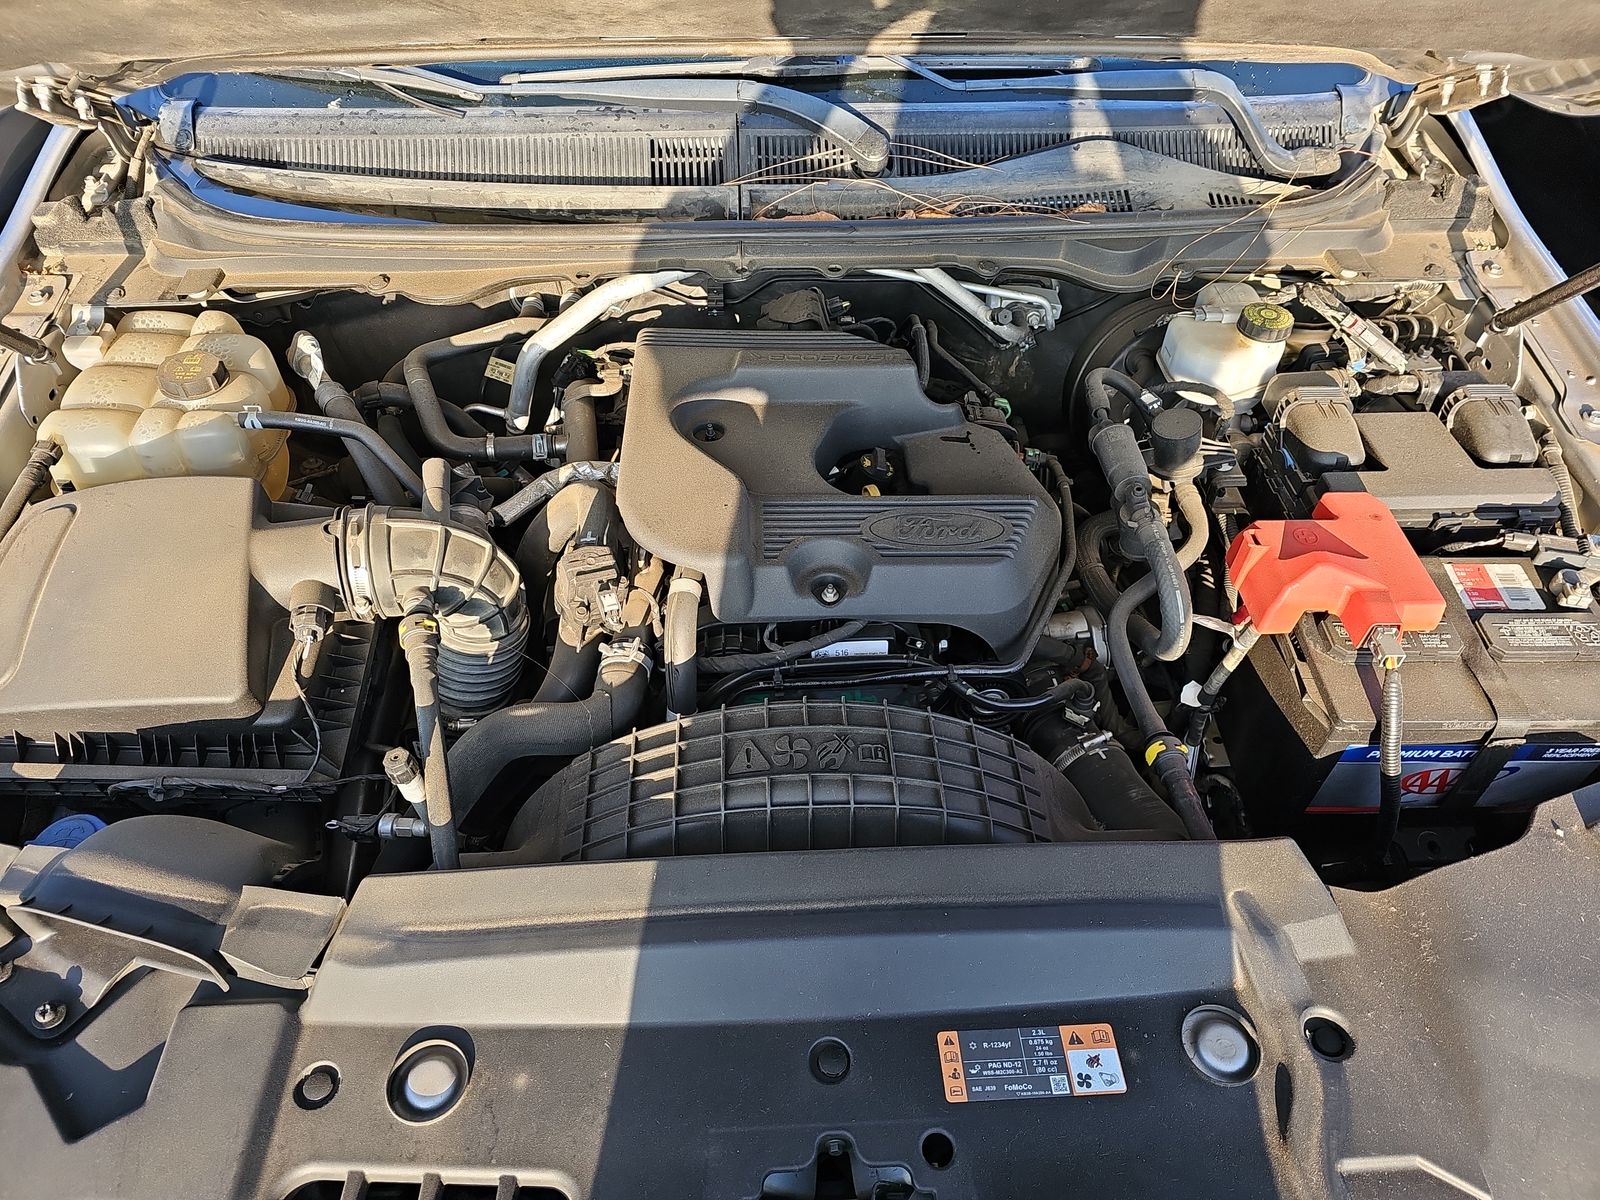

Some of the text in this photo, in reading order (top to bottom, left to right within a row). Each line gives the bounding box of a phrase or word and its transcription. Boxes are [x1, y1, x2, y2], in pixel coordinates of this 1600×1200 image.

[896, 514, 982, 540] Ford
[835, 649, 849, 657] 516
[1366, 749, 1479, 758] PMIUM BATT
[982, 1041, 1011, 1049] R-1234yf
[1044, 1038, 1054, 1046] kg
[1004, 1083, 1033, 1091] FoMoCo
